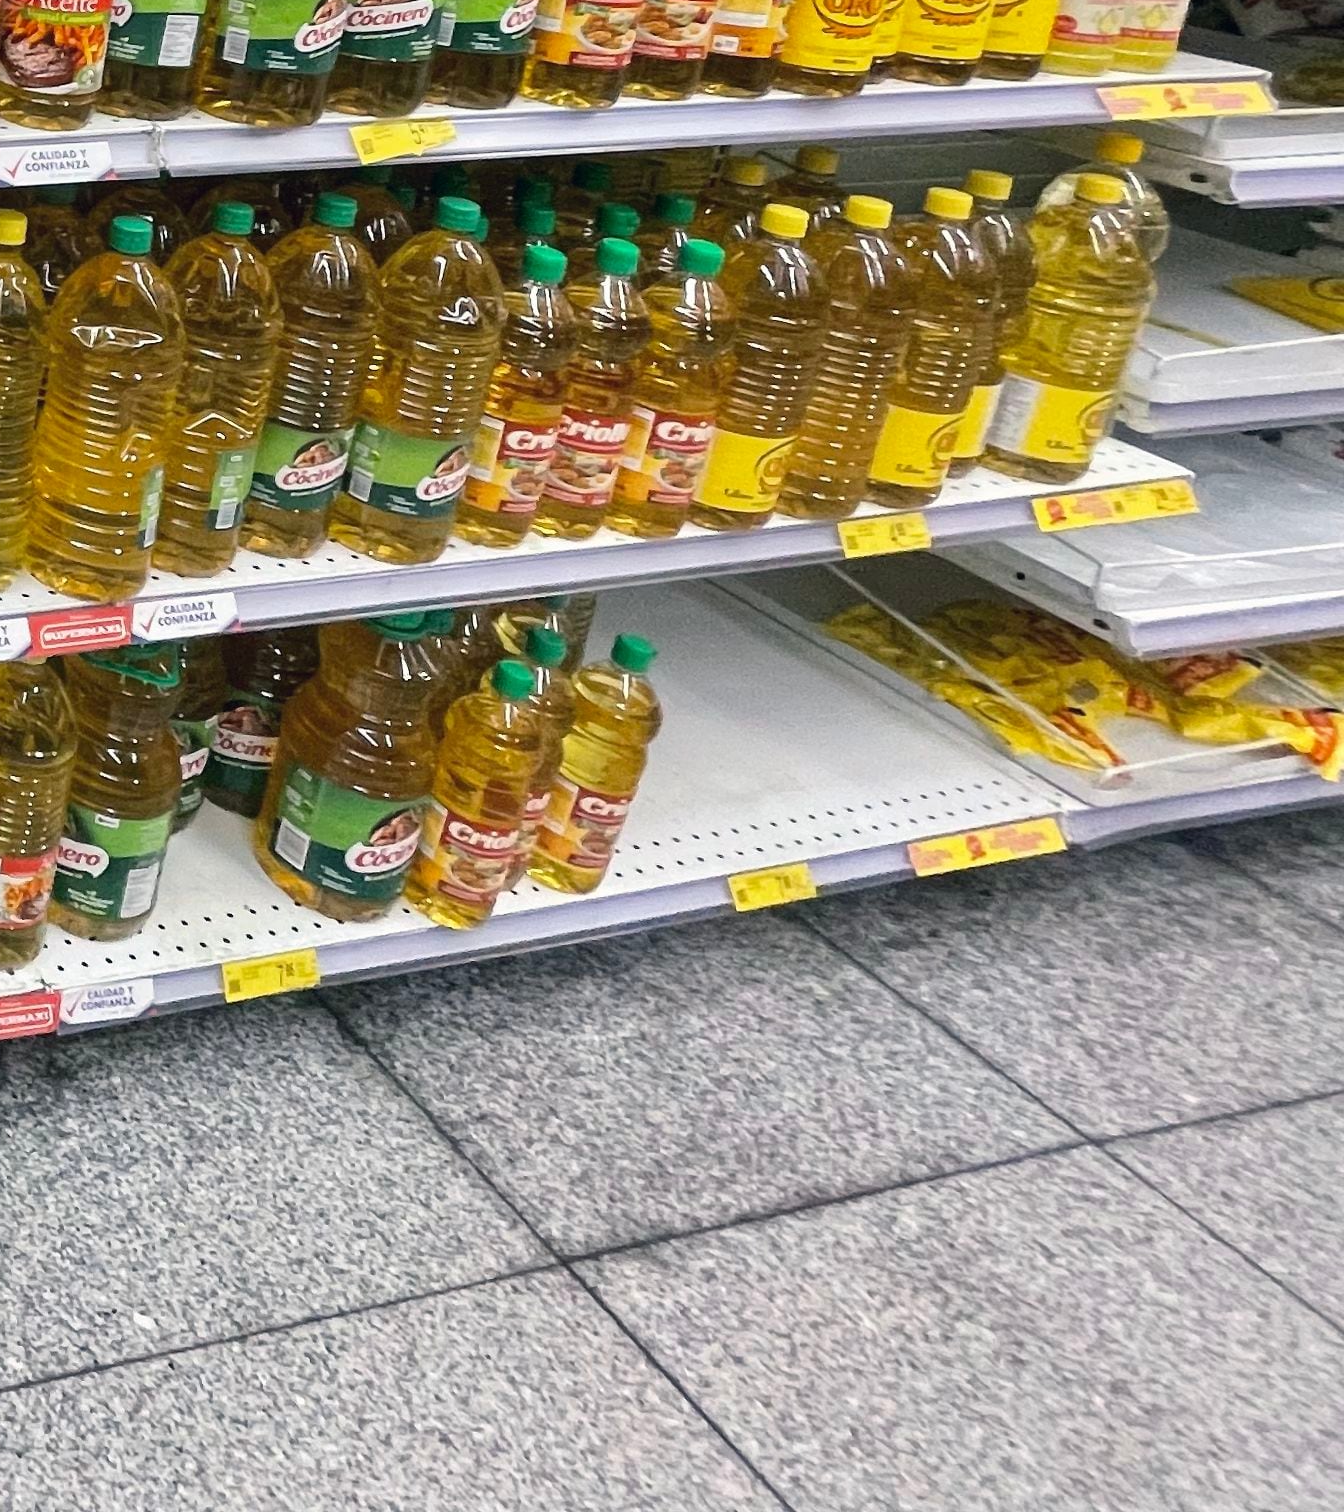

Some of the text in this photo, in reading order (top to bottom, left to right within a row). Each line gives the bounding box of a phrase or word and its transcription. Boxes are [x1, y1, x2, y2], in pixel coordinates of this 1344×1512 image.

[348, 5, 430, 29] Cocinero
[31, 149, 87, 162] CALIDAD Y
[24, 159, 90, 172] CONFIANZA
[163, 601, 214, 615] CALIDAD Y
[157, 609, 217, 626] CONFIANZA
[43, 624, 122, 643] SUPERMAXI
[87, 987, 125, 1000] CALIDAD
[80, 995, 136, 1010] CONFIANZA
